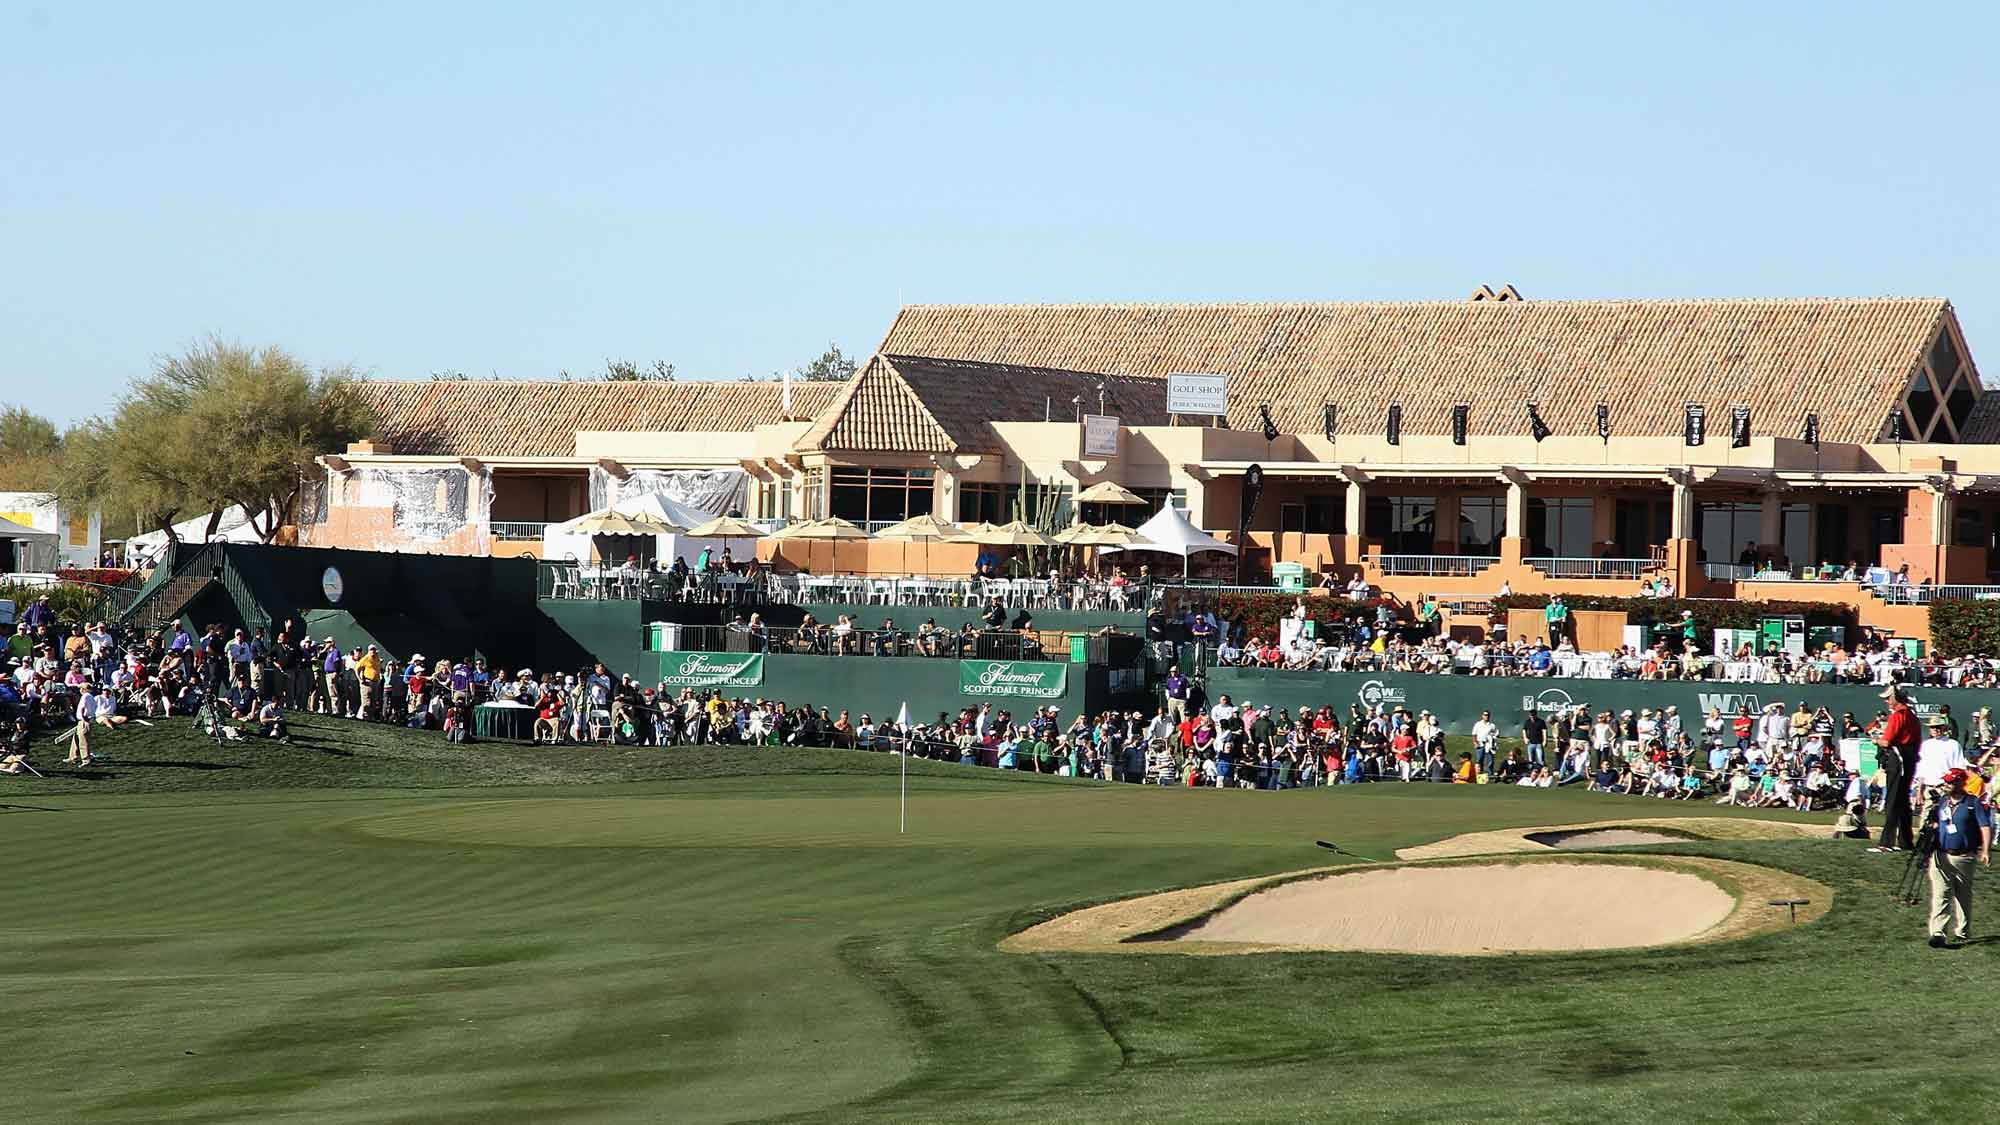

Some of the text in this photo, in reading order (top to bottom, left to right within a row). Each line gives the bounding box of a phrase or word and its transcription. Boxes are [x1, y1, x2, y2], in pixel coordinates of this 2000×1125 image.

[1173, 385, 1222, 394] GOLF SHOP
[679, 654, 744, 675] Fairmont
[663, 676, 759, 685] SCOTTSDALE PRINCESS
[980, 662, 1046, 686] Fairmont
[963, 685, 1062, 697] SCOTTSDALE PRINCESS
[1698, 694, 1761, 714] WM
